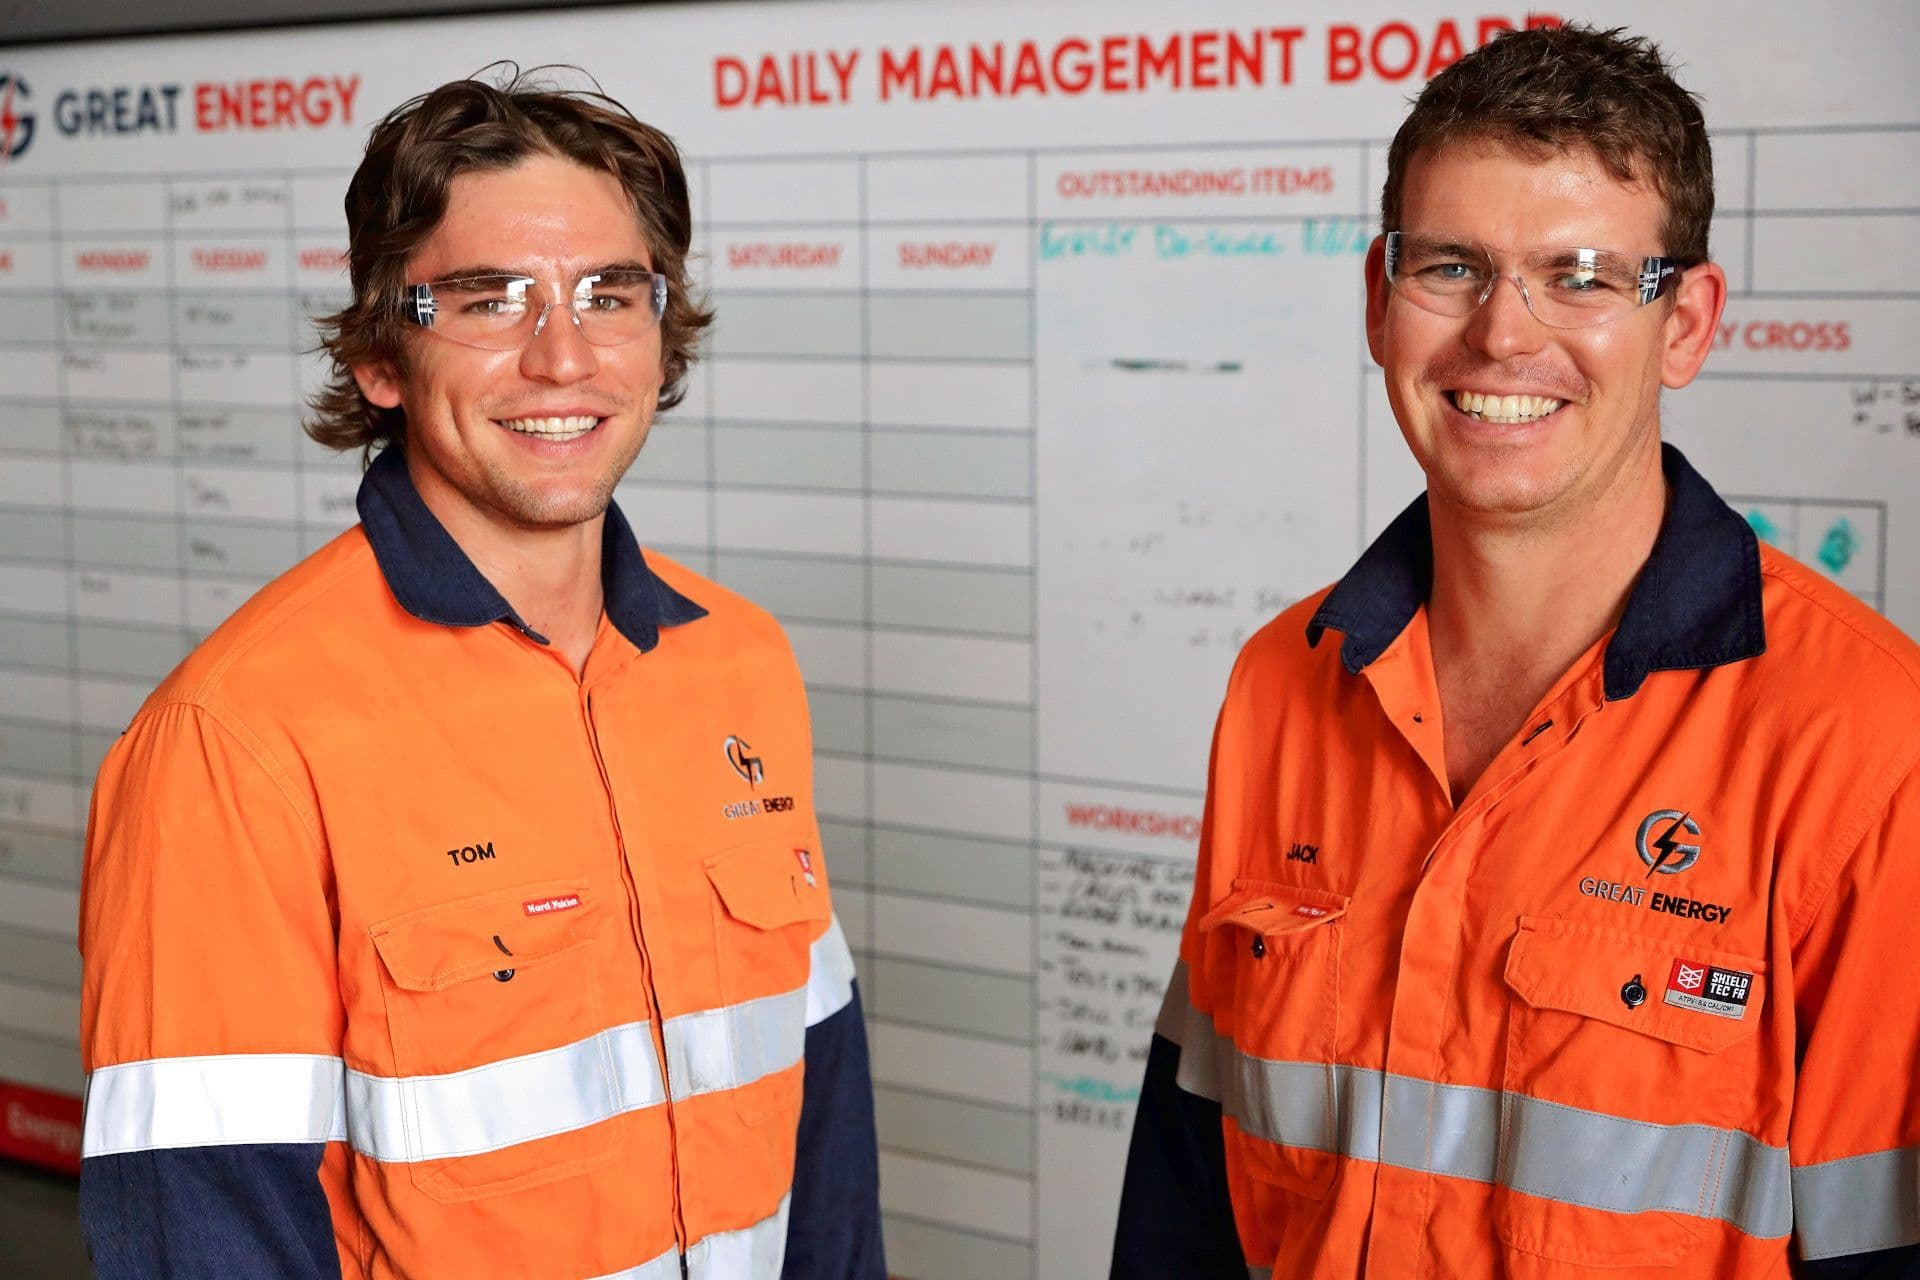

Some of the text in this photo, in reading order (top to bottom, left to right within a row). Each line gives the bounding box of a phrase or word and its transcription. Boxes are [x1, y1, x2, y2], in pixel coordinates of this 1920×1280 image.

[714, 16, 1565, 109] DAILY MANAGEMENT BOA
[54, 74, 361, 136] GREAT ENERGY
[1056, 166, 1336, 198] OUTSTANDING ITEMS
[76, 250, 151, 271] MONDAY
[192, 248, 267, 272] TUESDAY
[728, 243, 843, 269] SATURDAY
[898, 241, 996, 269] SUNDAY
[1743, 320, 1852, 352] CROSS
[723, 800, 762, 821] GREAT
[1065, 803, 1203, 841] WORKSHO
[447, 842, 496, 866] TOM
[1287, 843, 1319, 864] JACK
[527, 898, 578, 913] Hard Yakka
[1579, 877, 1732, 924] GREAT ENERGY
[1710, 983, 1746, 999] TEC FR
[1711, 972, 1748, 988] SHIELD
